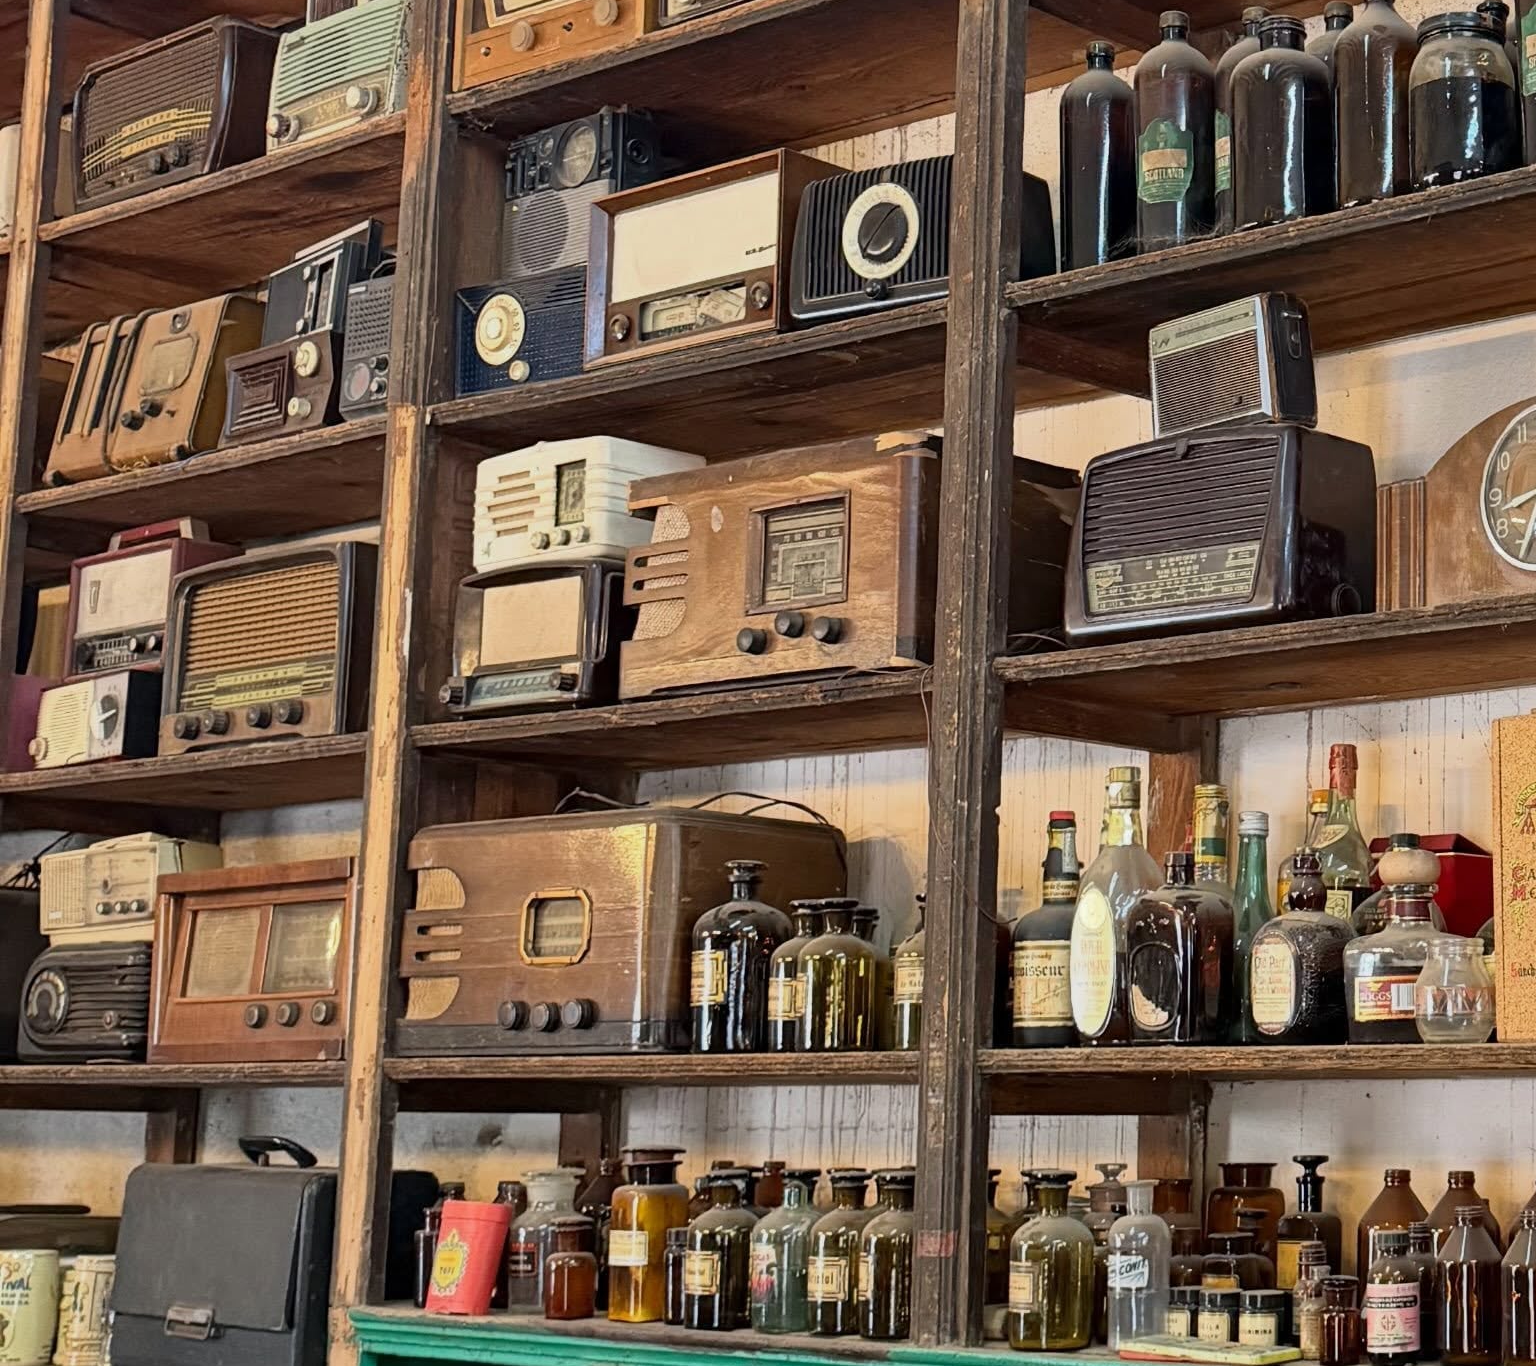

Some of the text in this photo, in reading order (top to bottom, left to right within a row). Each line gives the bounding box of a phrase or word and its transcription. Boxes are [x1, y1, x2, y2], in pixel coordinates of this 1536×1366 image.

[1144, 167, 1185, 183] SCOTLAND
[1516, 422, 1528, 444] 11
[1496, 450, 1511, 473] 10
[1489, 487, 1503, 508] 9
[1496, 518, 1508, 539] 8
